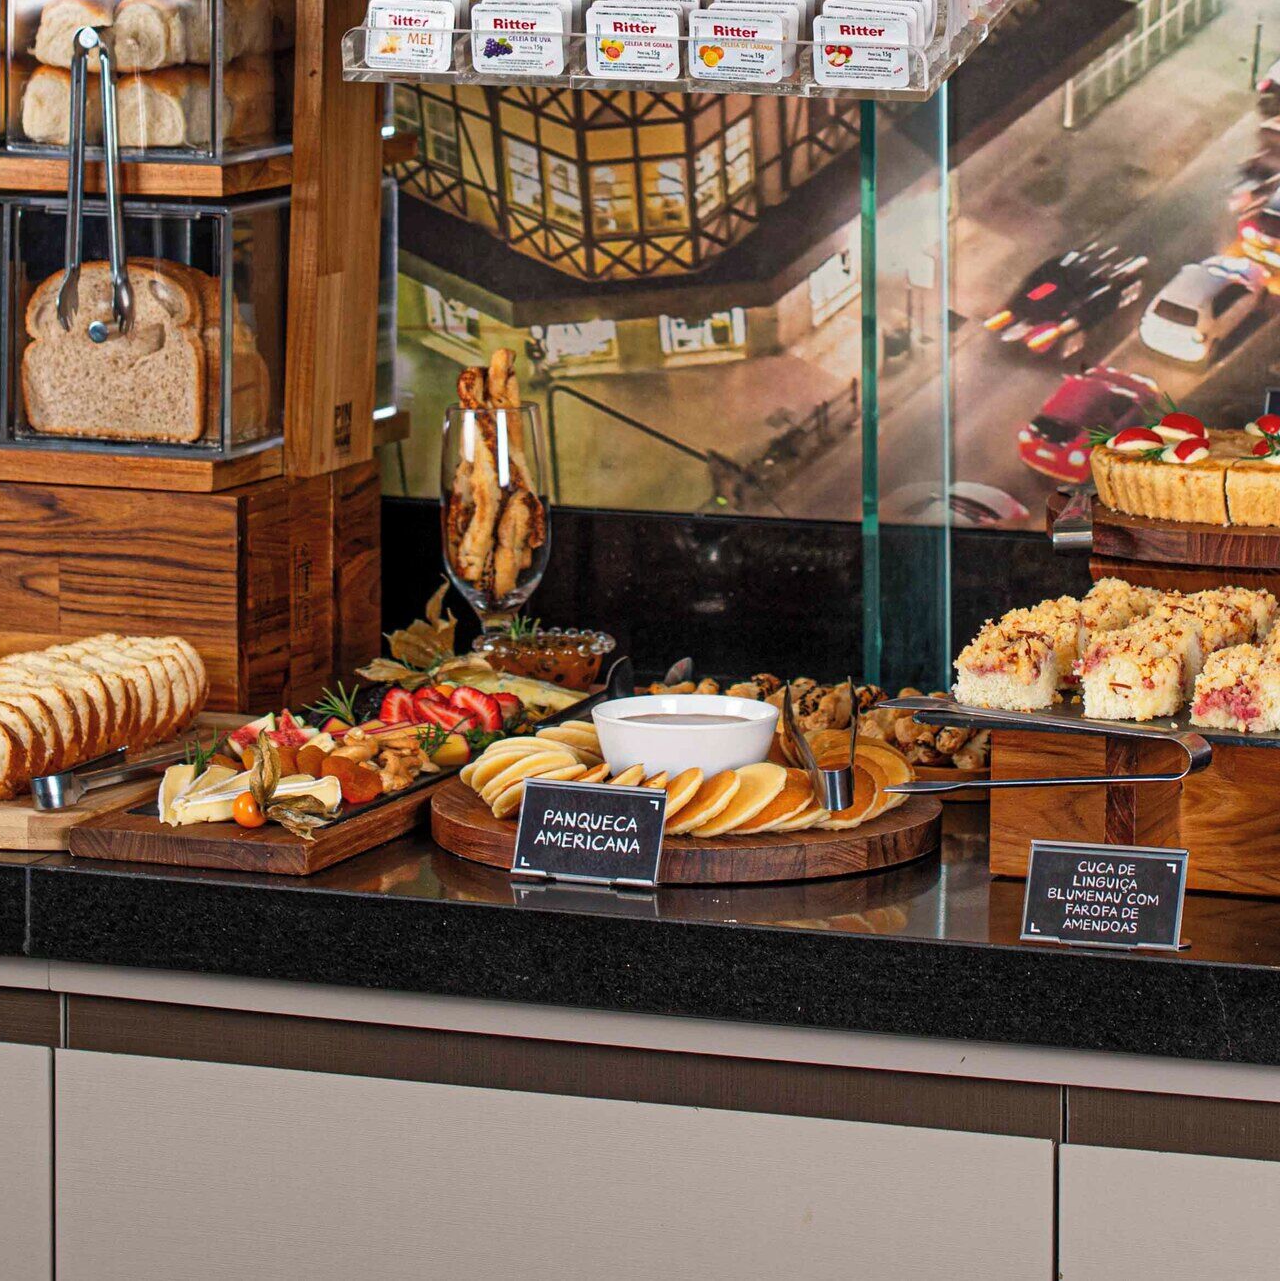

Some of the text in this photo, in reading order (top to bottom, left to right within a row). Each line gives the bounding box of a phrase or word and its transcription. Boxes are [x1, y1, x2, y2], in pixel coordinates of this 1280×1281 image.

[493, 18, 537, 30] Ritter
[613, 22, 656, 34] Ritter
[713, 25, 758, 38] Ritter
[839, 24, 885, 36] Ritter
[407, 32, 434, 45] MEL
[543, 809, 638, 833] PANQUECA
[534, 830, 641, 854] AMERICANA
[1078, 861, 1136, 876] CUCA DE
[1072, 875, 1138, 893] LINGUIÇA
[1047, 887, 1159, 906] BLUMENAU COM
[1065, 903, 1139, 919] FAROFA DE
[1062, 918, 1138, 934] AMENDOAS
